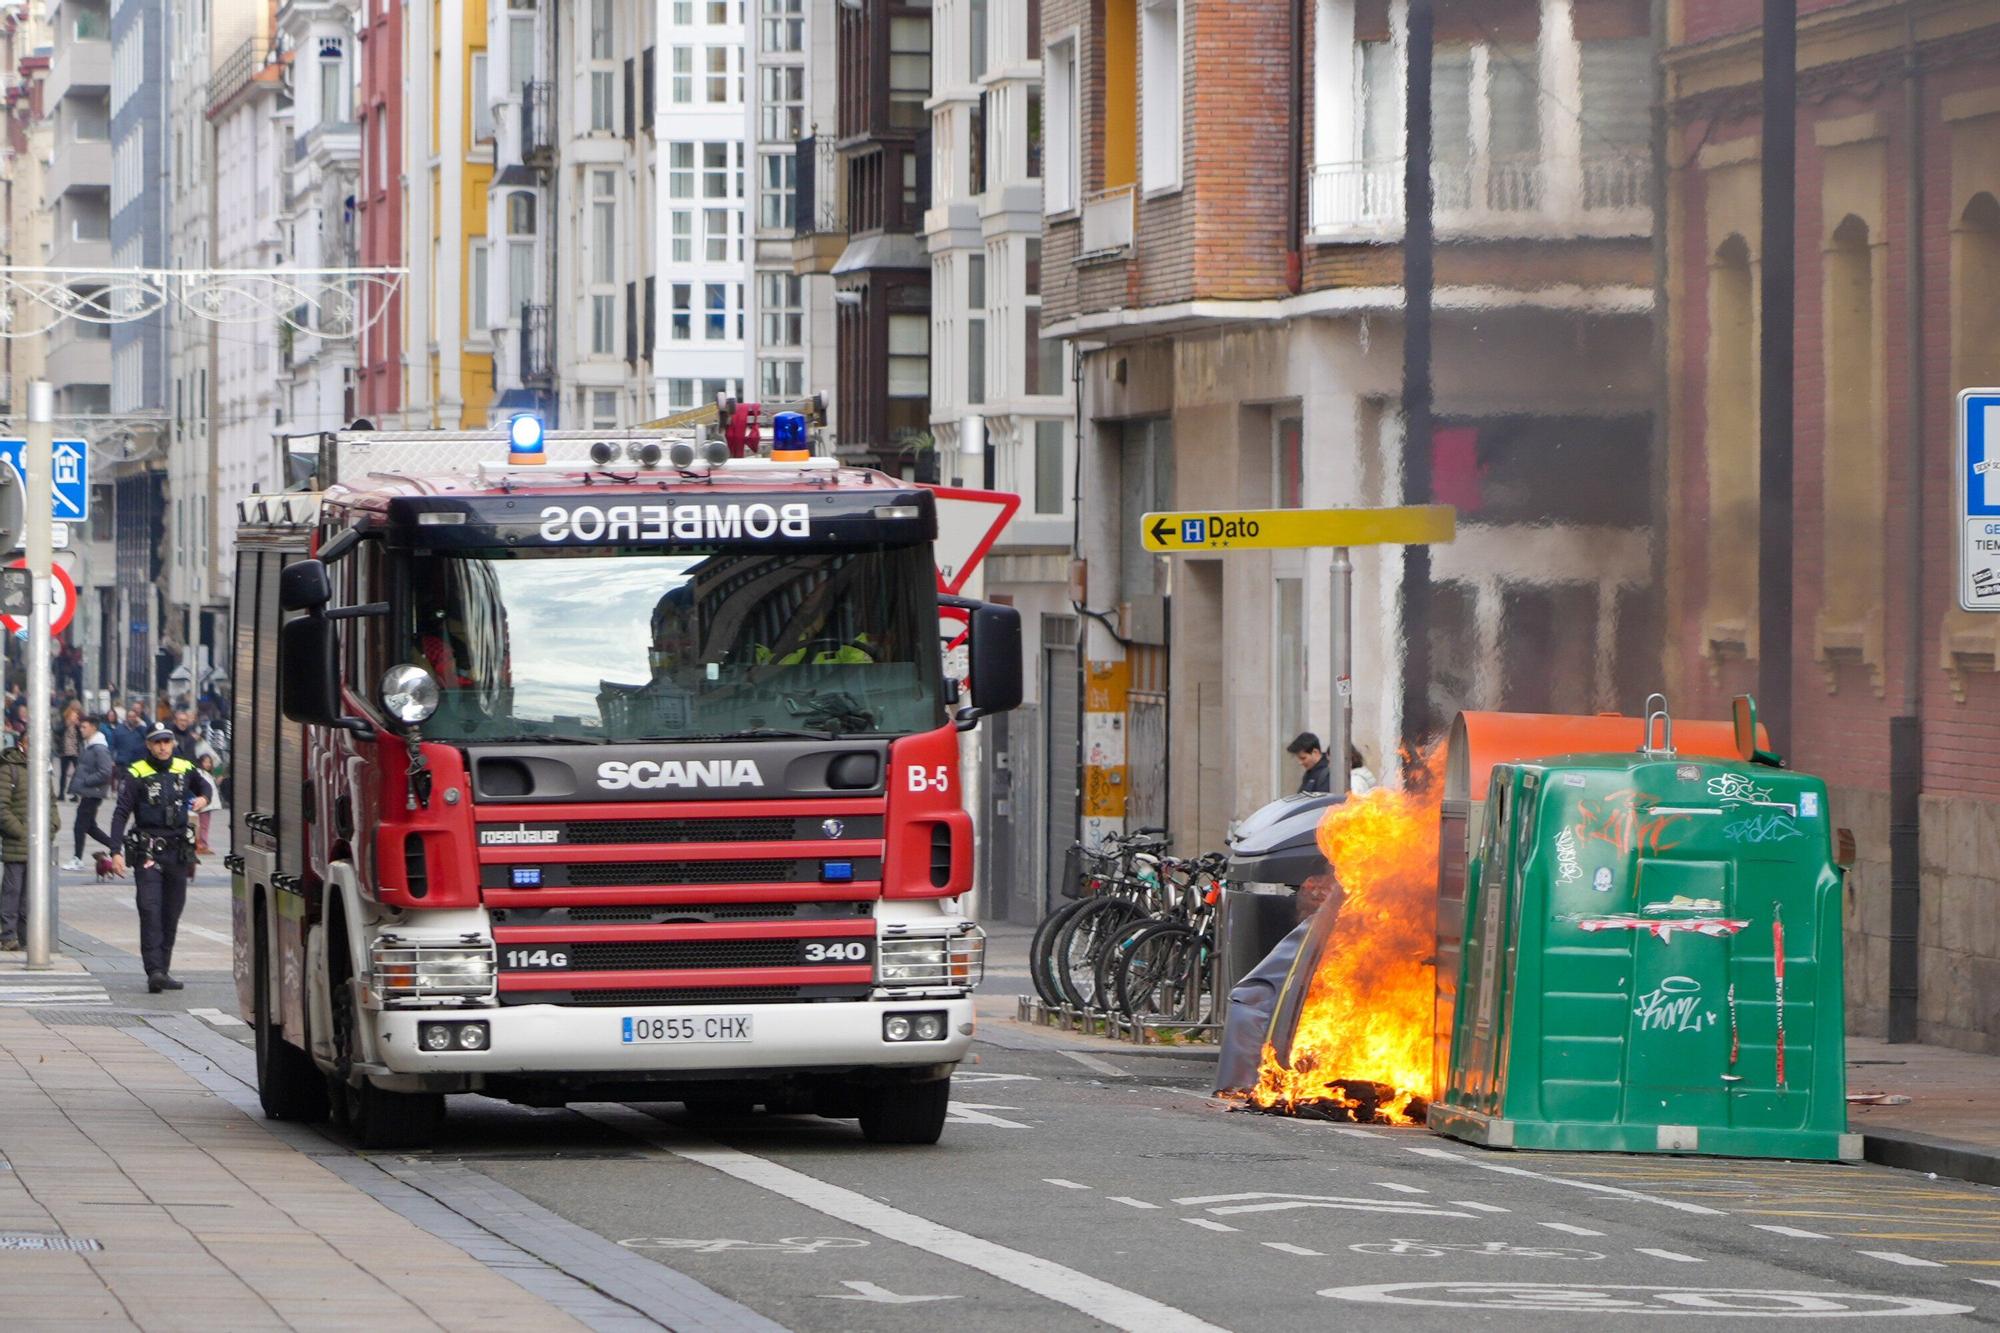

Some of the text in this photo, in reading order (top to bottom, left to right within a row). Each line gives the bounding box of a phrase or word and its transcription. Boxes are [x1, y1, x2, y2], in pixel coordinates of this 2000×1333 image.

[1183, 516, 1259, 541] H Dato
[597, 760, 765, 790] SCANIA
[908, 765, 948, 792] B-5
[480, 823, 561, 844] rosenbauer
[506, 949, 568, 968] 114G
[804, 942, 867, 961] 340
[637, 1017, 747, 1040] 0855 CHX
